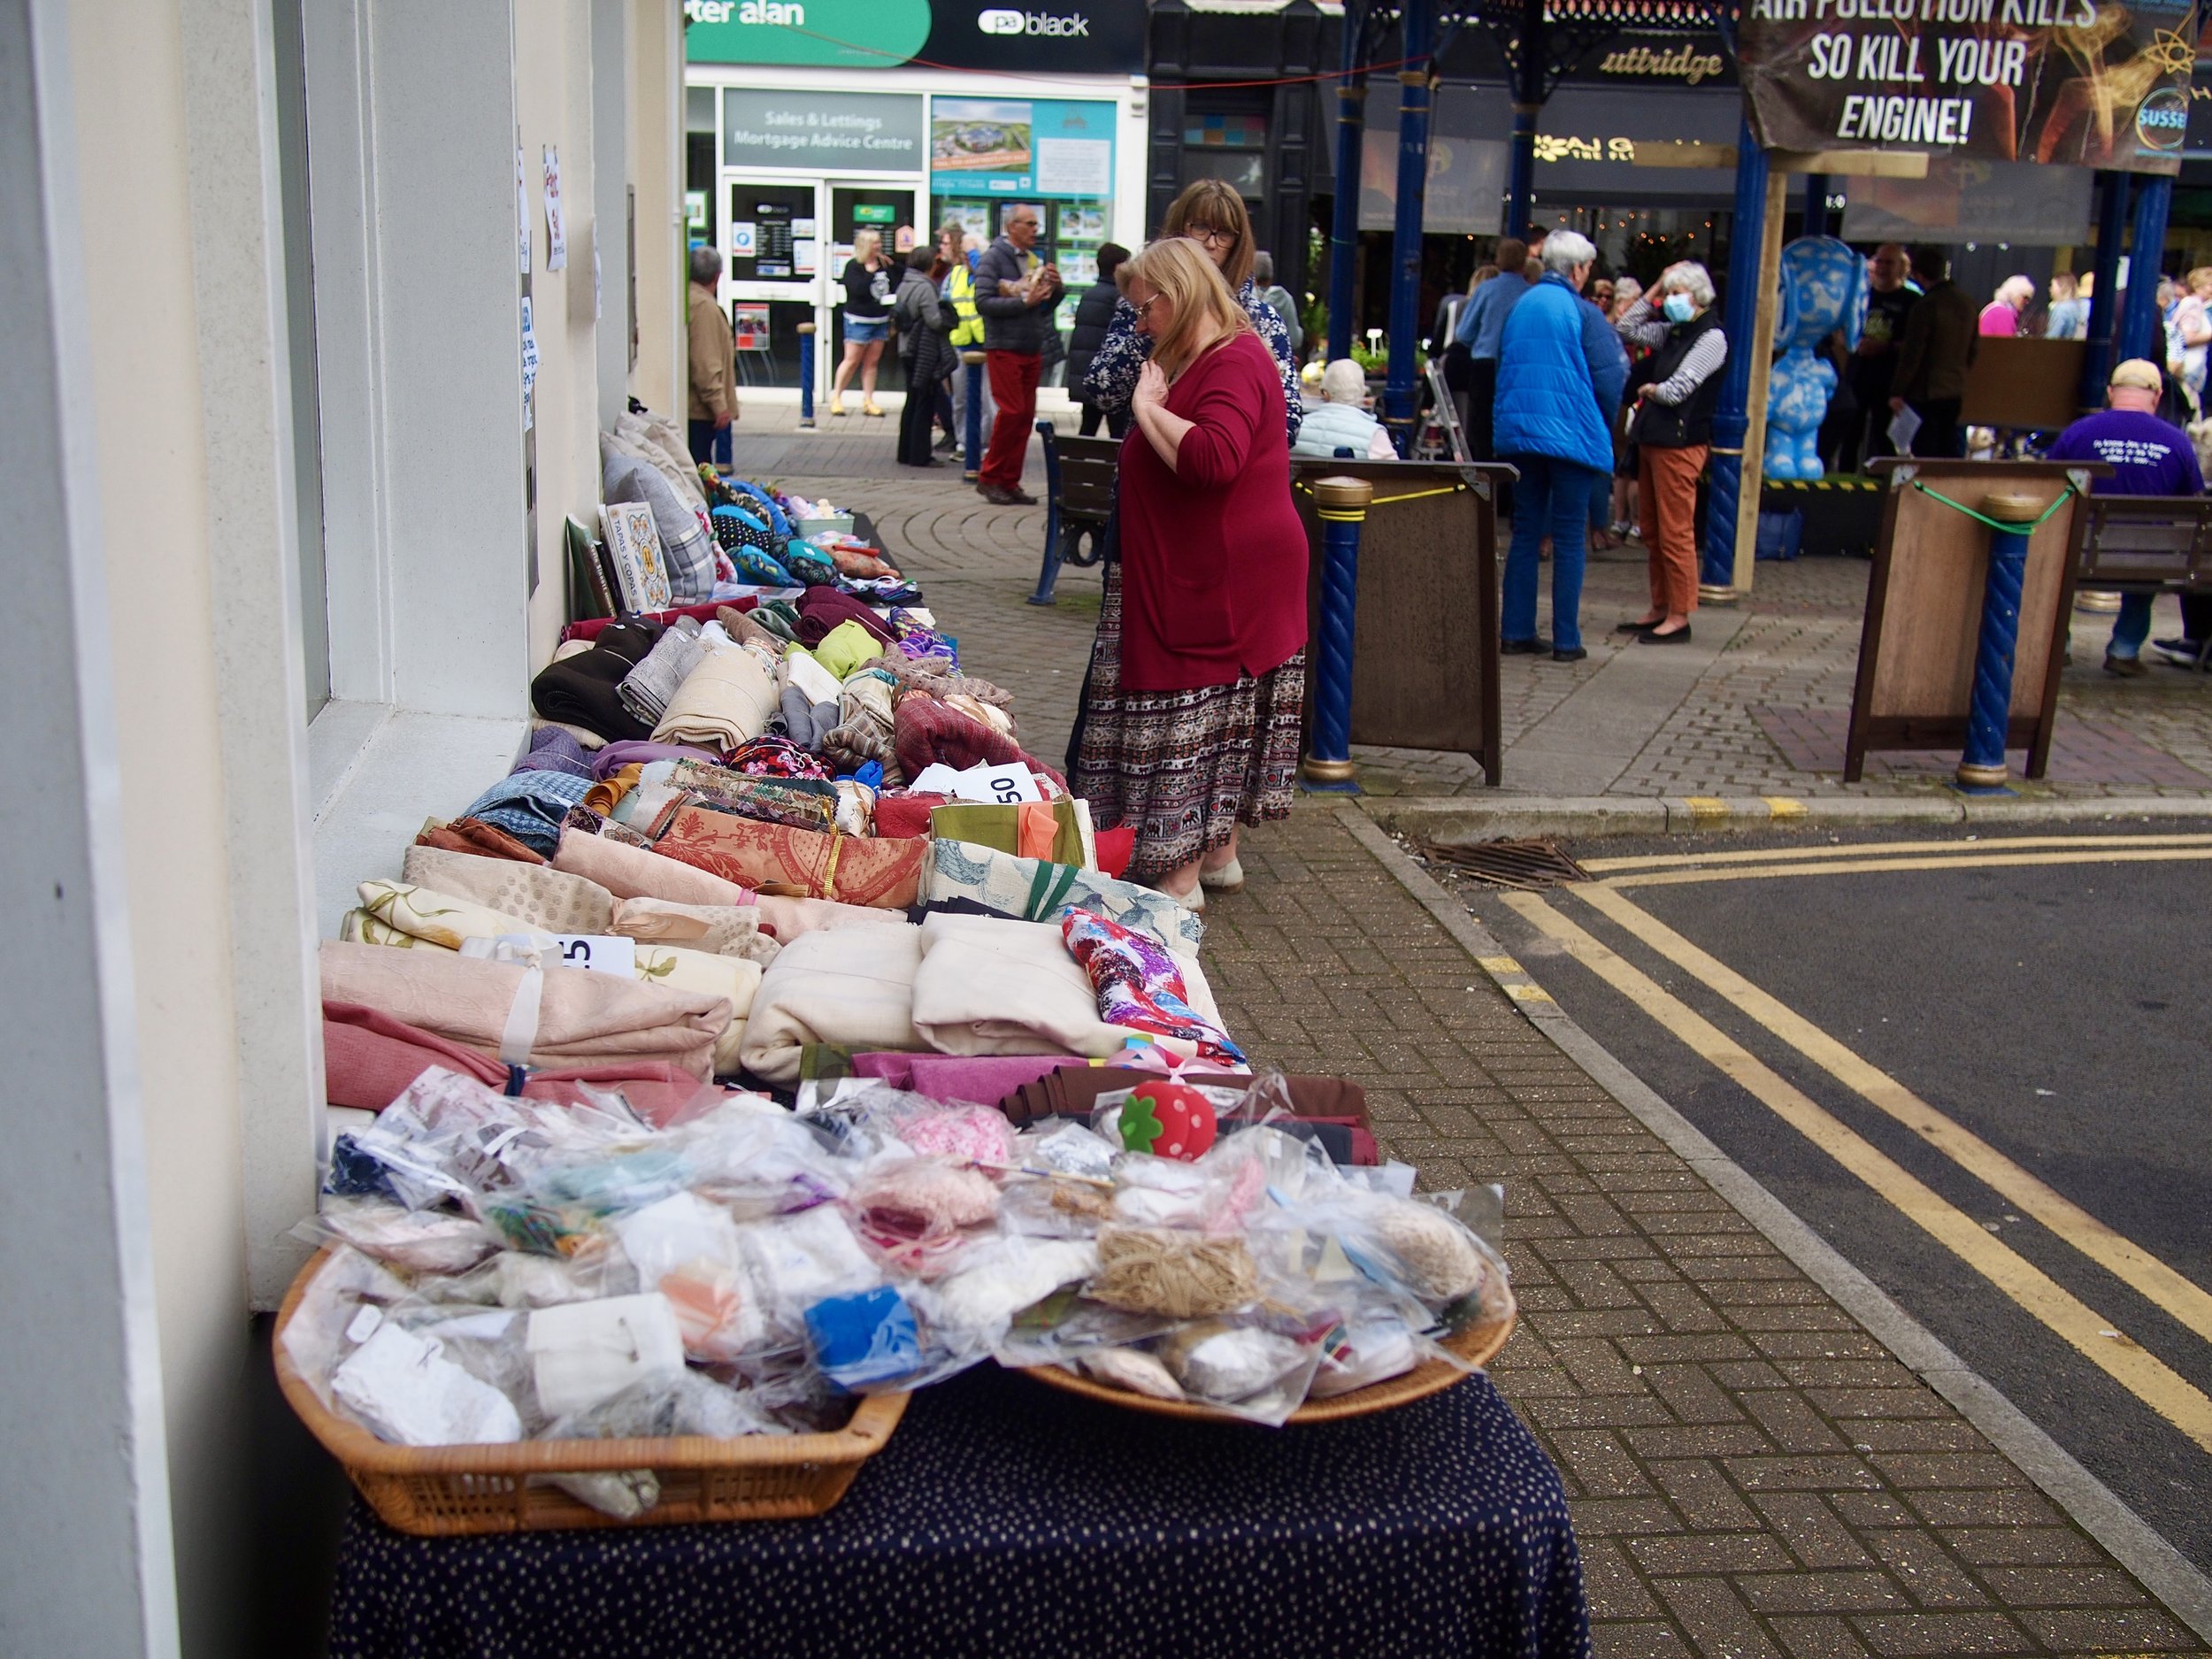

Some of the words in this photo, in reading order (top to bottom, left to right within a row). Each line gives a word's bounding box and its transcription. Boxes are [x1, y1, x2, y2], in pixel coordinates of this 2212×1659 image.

[684, 0, 734, 23] ter
[739, 0, 805, 26] alan
[1025, 11, 1089, 36] black
[1808, 33, 1853, 80] SO
[1856, 35, 1925, 82] KILL
[1938, 37, 2027, 87] YOUR
[764, 111, 804, 127] Sales
[806, 112, 818, 127] &
[821, 112, 883, 132] Lettings
[1836, 95, 1973, 144] ENGINE!
[733, 130, 809, 150] Mortgage
[810, 133, 861, 149] Advice
[863, 134, 913, 150] Centre
[625, 565, 637, 597] COPAS
